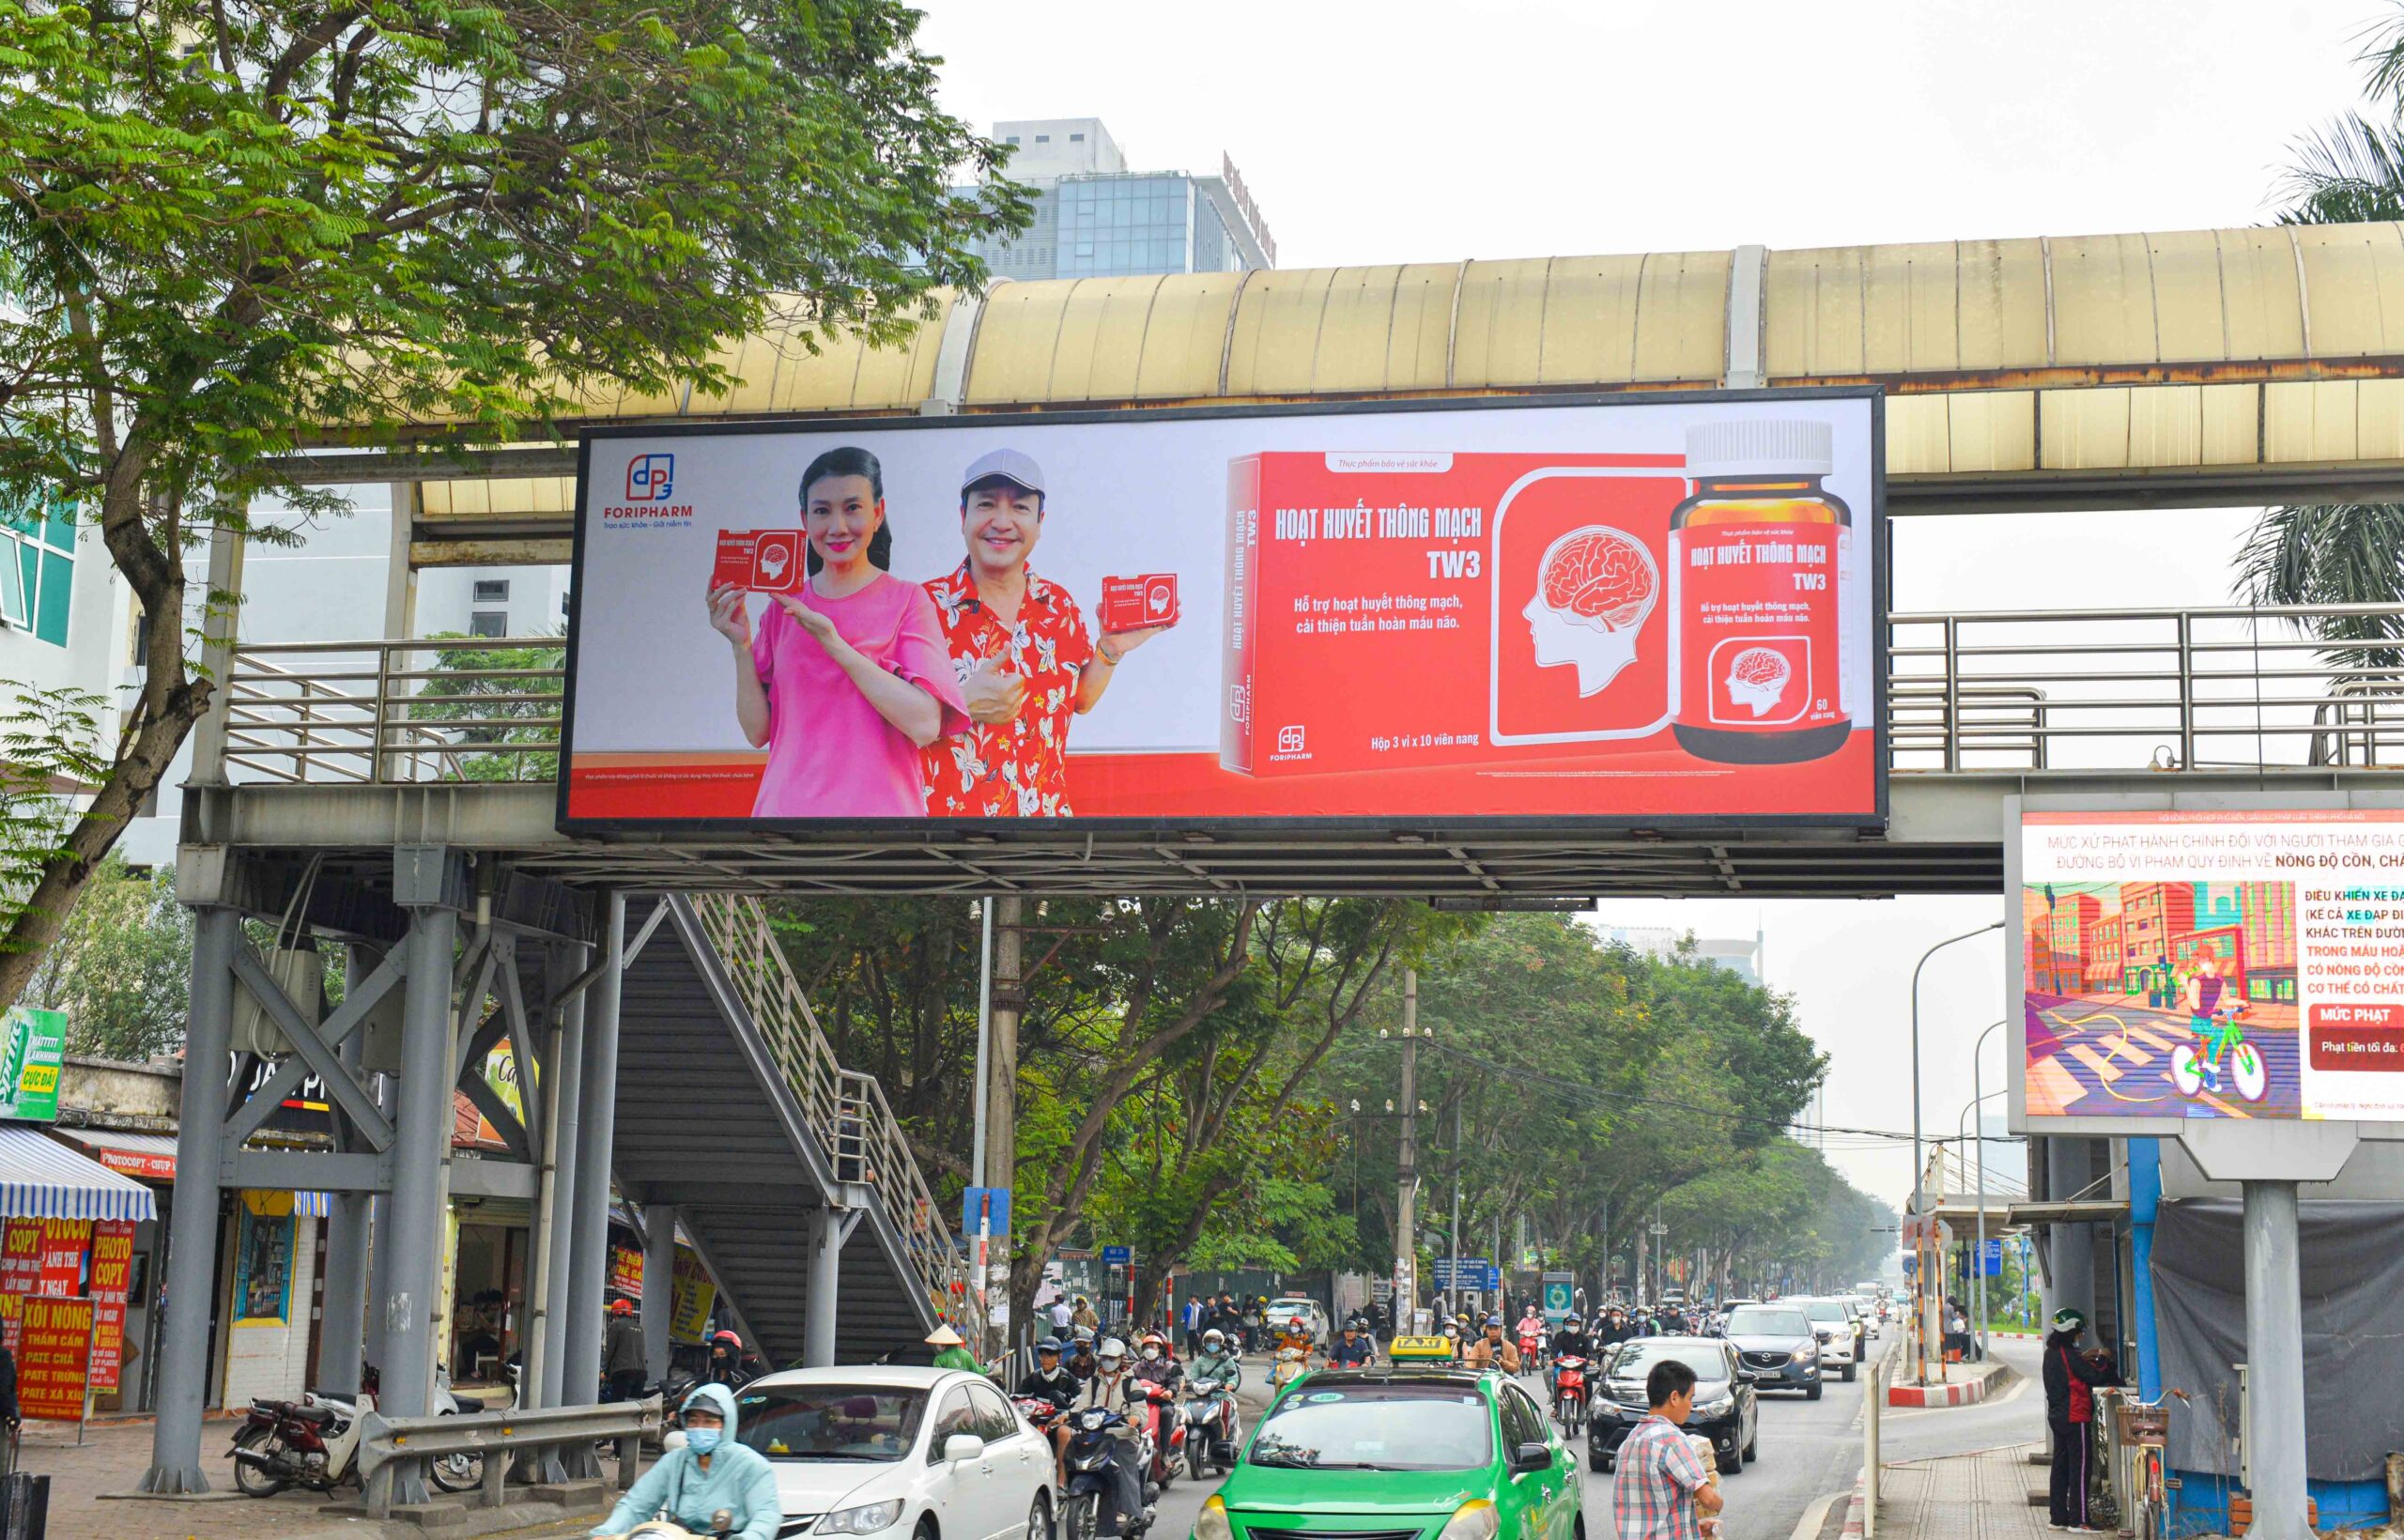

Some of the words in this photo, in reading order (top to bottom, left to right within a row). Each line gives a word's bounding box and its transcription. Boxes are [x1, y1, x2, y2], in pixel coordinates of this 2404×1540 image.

[604, 505, 693, 518] FORIPHARM
[1247, 509, 1256, 547] TW3
[1275, 508, 1318, 547] HOẠT
[1323, 498, 1373, 539] HUYẾT
[1378, 502, 1429, 538] THÔNG
[1434, 507, 1482, 545] MẠCH
[1690, 547, 1715, 570] HOẠT
[1718, 539, 1751, 564] HUYẾT
[1755, 541, 1793, 563] THÔNG
[1796, 545, 1826, 567] MẠCH
[1426, 550, 1481, 579] TW3
[1793, 573, 1826, 591] TW3
[1294, 595, 1309, 612] Hỗ
[1313, 599, 1330, 614] trợ
[1333, 596, 1358, 613] hoạt
[1362, 593, 1393, 612] huyết
[1395, 595, 1427, 611] thông
[1430, 594, 1463, 610] mạch,
[1296, 618, 1314, 633] cải
[1318, 619, 1347, 636] thiện
[1349, 614, 1375, 632] tuần
[1379, 616, 1406, 631] hoàn
[1410, 615, 1433, 629] máu
[1437, 615, 1460, 628] não.
[1816, 699, 1827, 711] 60
[1371, 737, 1391, 752] Hộp
[1393, 736, 1399, 748] 3
[1401, 734, 1410, 747] vỉ
[1411, 738, 1418, 747] x
[1420, 734, 1431, 747] 10
[1434, 733, 1454, 746] viên
[1456, 733, 1479, 746] nang
[1270, 752, 1312, 762] FORIPHARM
[2048, 833, 2077, 849] MỨC
[2141, 833, 2178, 848] HÀNH
[2182, 832, 2225, 848] CHÍNH
[2228, 832, 2251, 848] ĐỐI
[2255, 832, 2276, 847] VỚI
[2281, 832, 2323, 848] NGƯỜI
[2328, 834, 2367, 847] THAM
[2372, 834, 2394, 847] GIA
[2057, 854, 2104, 869] ĐƯỜNG
[2108, 852, 2126, 870] BỘ
[2130, 855, 2141, 869] VI
[2146, 855, 2184, 870] PHẠM
[2187, 855, 2214, 869] QUY
[2217, 855, 2251, 870] ĐỊNH
[2255, 852, 2273, 867] VỀ
[2275, 851, 2315, 868] NỒNG
[2319, 852, 2338, 870] ĐỘ
[2342, 851, 2376, 869] CỒN,
[2305, 887, 2331, 901] ĐIỀU
[2335, 887, 2370, 901] KHIỂN
[2373, 890, 2388, 901] XE
[2391, 890, 2404, 904] ĐẠ
[2327, 906, 2344, 920] CẢ
[2346, 909, 2362, 920] XE
[2365, 909, 2389, 922] ĐẠP
[2305, 926, 2338, 938] KHÁC
[2341, 925, 2372, 938] TRÊN
[2306, 946, 2348, 957] TRONG
[2350, 943, 2378, 957] MÁU
[2307, 962, 2324, 976] CÓ
[2326, 962, 2361, 976] NỒNG
[2364, 962, 2381, 978] ĐỘ
[2307, 982, 2324, 993] CƠ
[2327, 980, 2350, 993] THỂ
[2353, 981, 2370, 994] CÓ
[2320, 1006, 2351, 1021] MỨC
[2354, 1009, 2391, 1024] PHẠT
[2321, 1041, 2345, 1054] Phạt
[2347, 1041, 2365, 1053] tiền
[2367, 1041, 2381, 1053] tối
[2382, 1041, 2398, 1053] đa:
[23, 1070, 41, 1089] CỰC
[102, 1152, 146, 1168] PHOTOCOPY
[151, 1159, 171, 1173] CHỤP
[8, 1228, 39, 1254] COPY
[94, 1237, 131, 1260] PHOTO
[46, 1245, 63, 1268] ẢNH
[63, 1245, 79, 1268] THẺ
[5, 1273, 16, 1290] LẤY
[17, 1278, 32, 1291] NGAY
[95, 1262, 126, 1286] COPY
[46, 1280, 69, 1296] NGAY
[103, 1287, 116, 1303] ẢNH
[23, 1300, 48, 1328] XÔI
[51, 1301, 92, 1331] NÓNG
[103, 1310, 118, 1322] NGAY
[1397, 1338, 1441, 1348] TAXI
[25, 1352, 50, 1363] PATE
[53, 1350, 74, 1365] CHẢ
[23, 1369, 48, 1381] PATE
[51, 1369, 85, 1383] TRỨNG
[22, 1387, 47, 1399] PATE
[49, 1387, 64, 1400] XÁ
